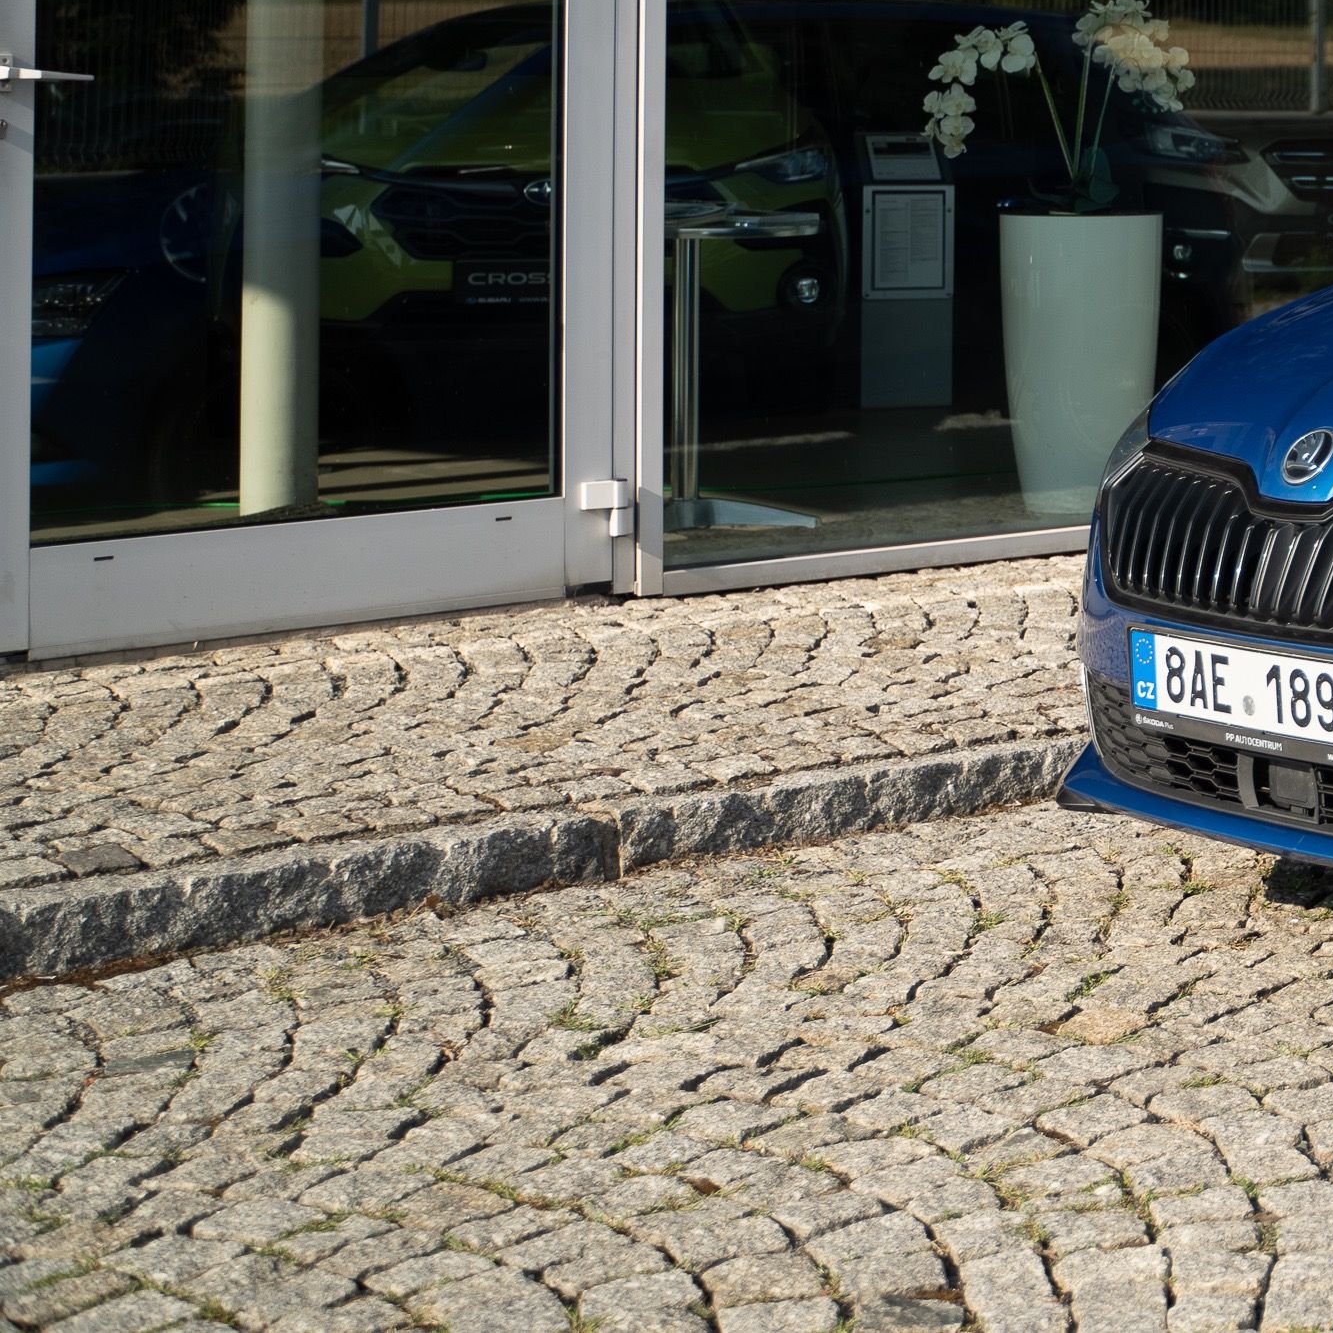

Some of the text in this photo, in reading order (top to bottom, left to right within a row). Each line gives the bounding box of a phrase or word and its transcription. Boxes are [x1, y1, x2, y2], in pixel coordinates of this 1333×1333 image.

[1136, 680, 1156, 700] CZ
[1165, 646, 1232, 714] 8AE
[1225, 732, 1283, 752] PP AUTOCENTRUM
